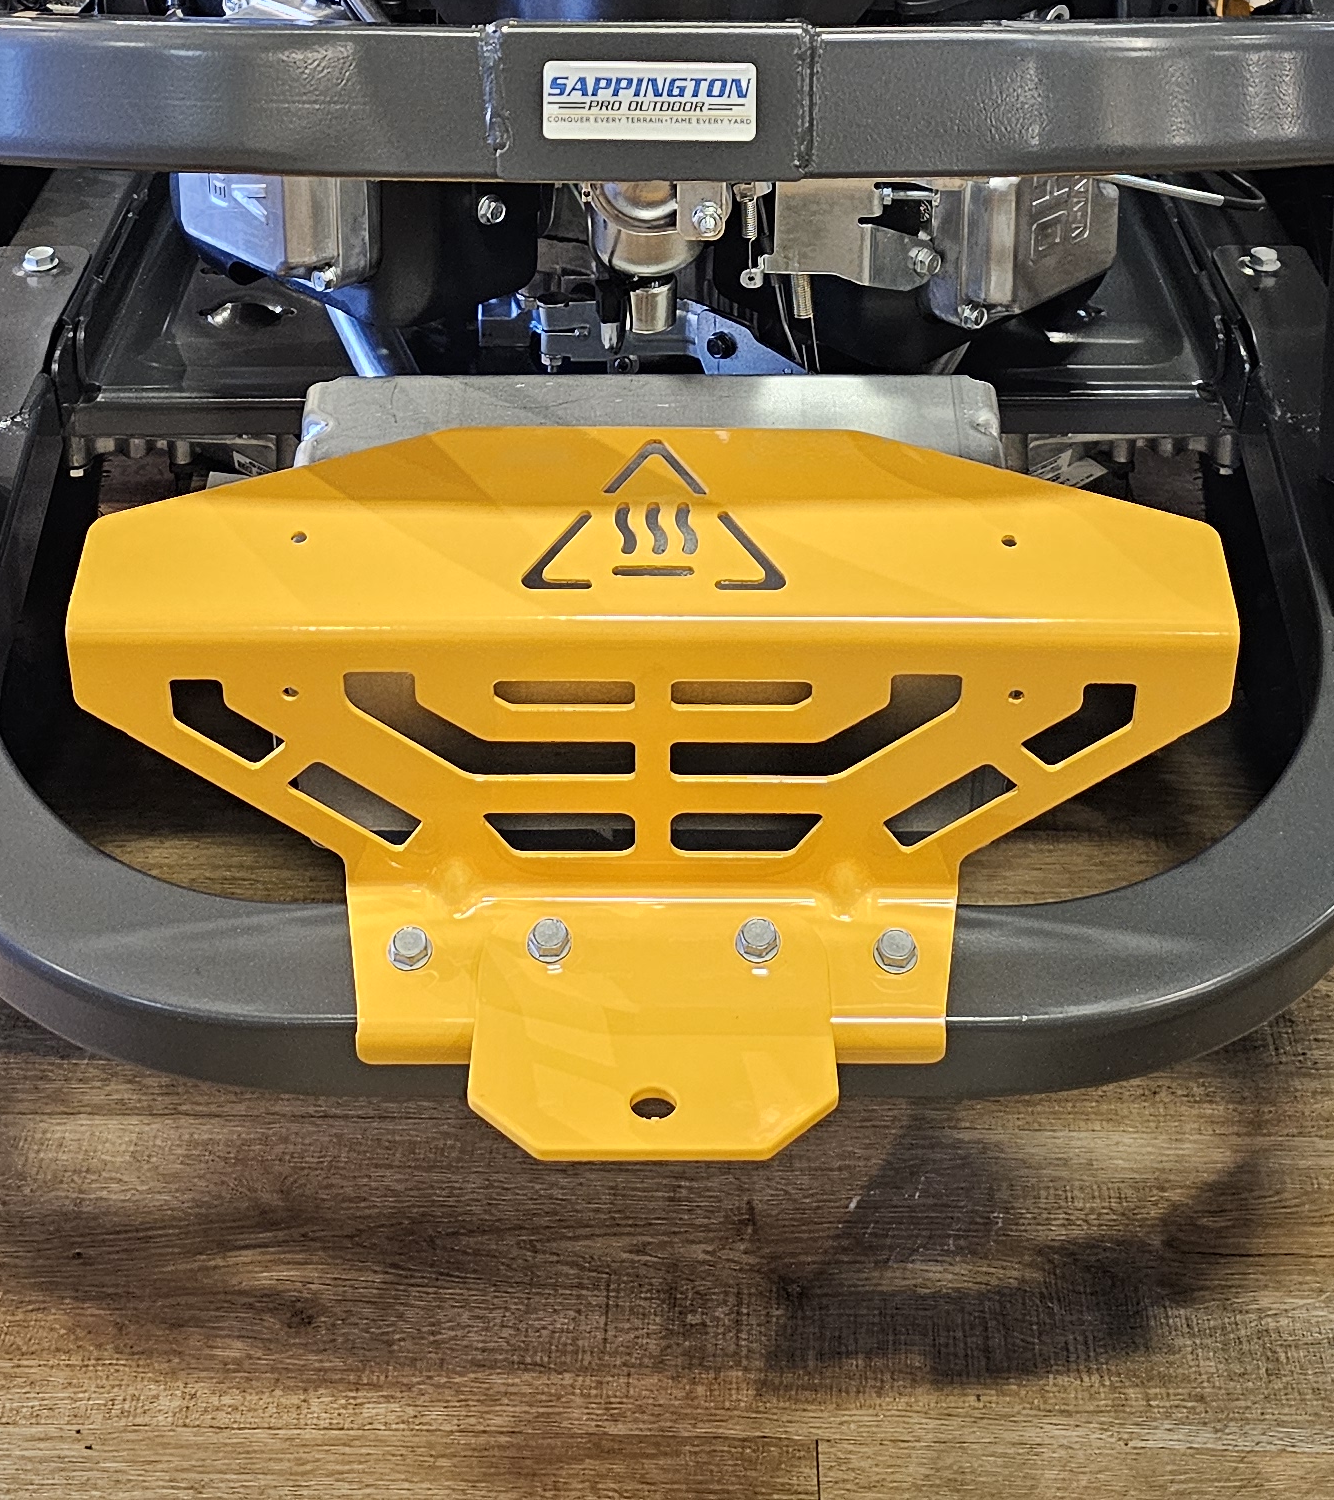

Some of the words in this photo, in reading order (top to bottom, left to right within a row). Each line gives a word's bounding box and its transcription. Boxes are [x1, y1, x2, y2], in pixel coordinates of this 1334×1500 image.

[547, 76, 752, 98] SAPPINGTON
[587, 101, 622, 112] PRO
[627, 101, 706, 113] OUTDOOR
[547, 115, 591, 123] CONQUER
[594, 116, 623, 124] EVERY
[696, 117, 725, 125] EVERY
[727, 117, 752, 125] YARD
